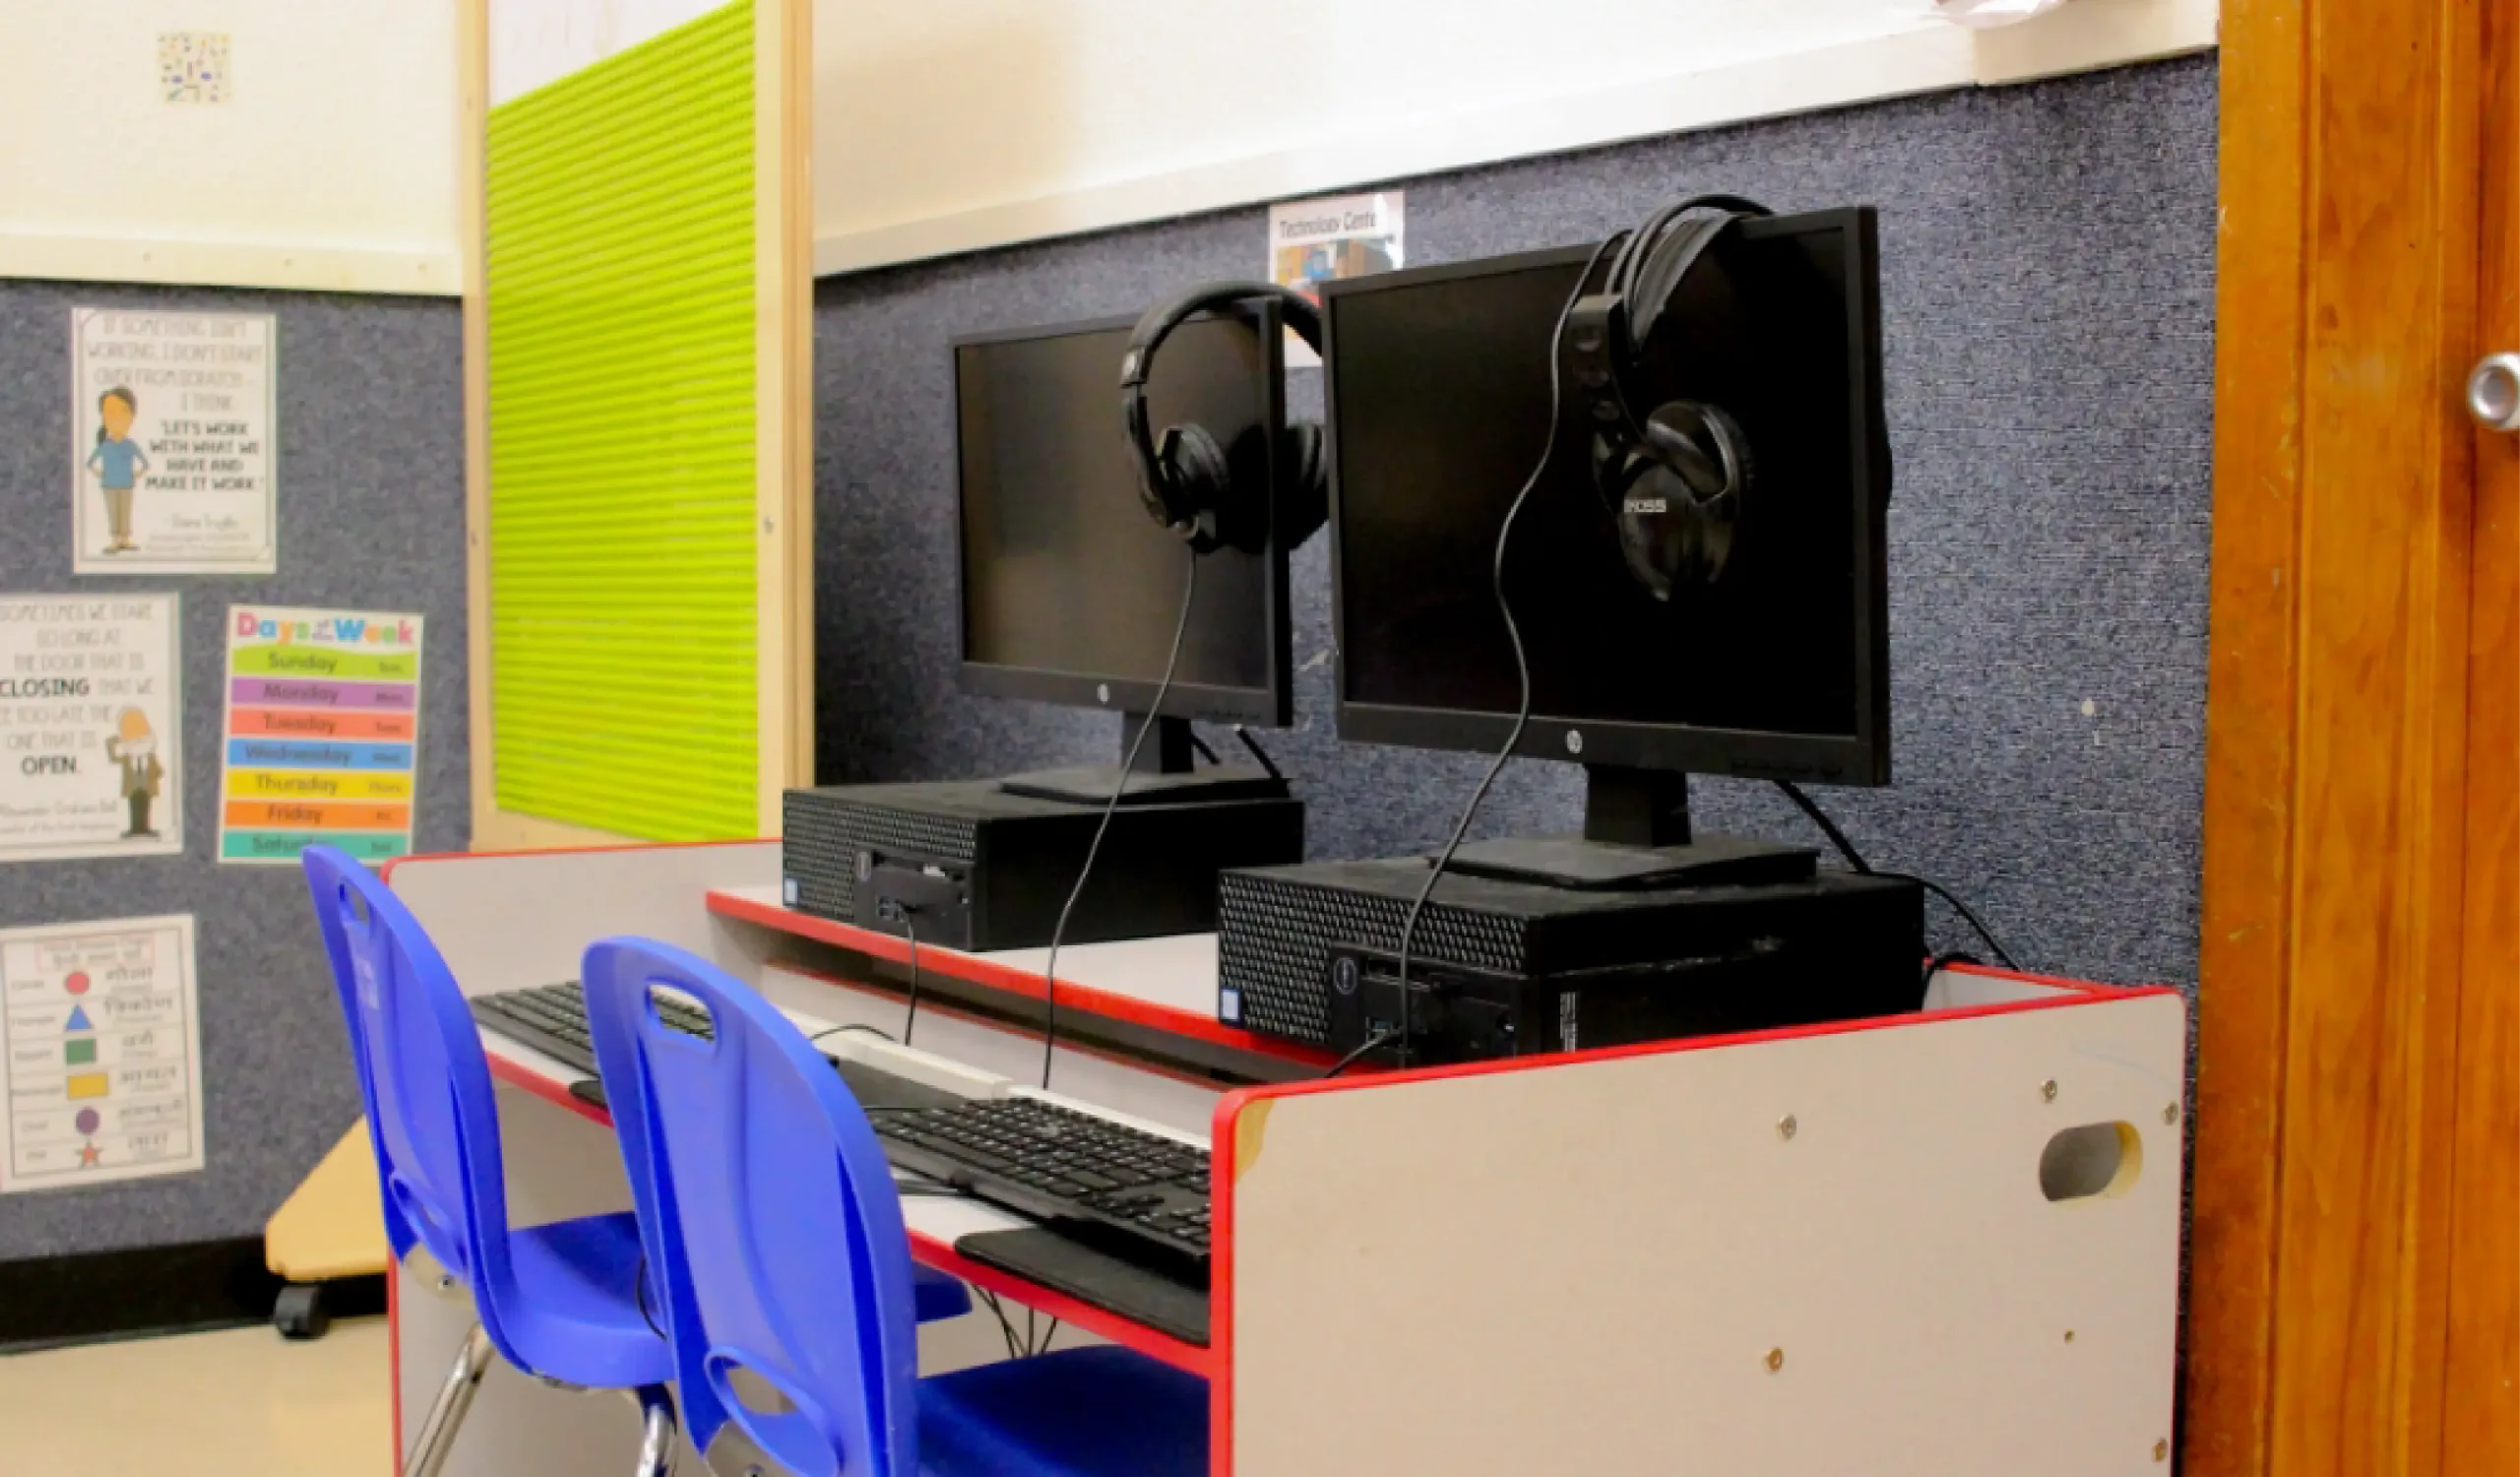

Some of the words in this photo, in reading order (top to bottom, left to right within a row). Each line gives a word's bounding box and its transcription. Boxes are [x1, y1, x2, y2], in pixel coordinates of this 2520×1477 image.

[206, 421, 248, 435] WORK
[150, 439, 188, 453] WITH
[193, 440, 233, 454] WHAT
[238, 440, 259, 454] WE
[166, 458, 206, 472] HAVE
[211, 459, 244, 472] AND
[145, 476, 186, 489] MAKE
[191, 477, 207, 489] IT
[238, 611, 310, 645] Days
[334, 617, 414, 645] Week
[268, 651, 339, 674] Sunday
[0, 677, 91, 698] CLOSING
[264, 683, 341, 705] Monday
[263, 713, 338, 736] Tuesday
[245, 743, 350, 765] Wednesday
[256, 774, 339, 797] Thursday
[268, 803, 324, 825] Friday
